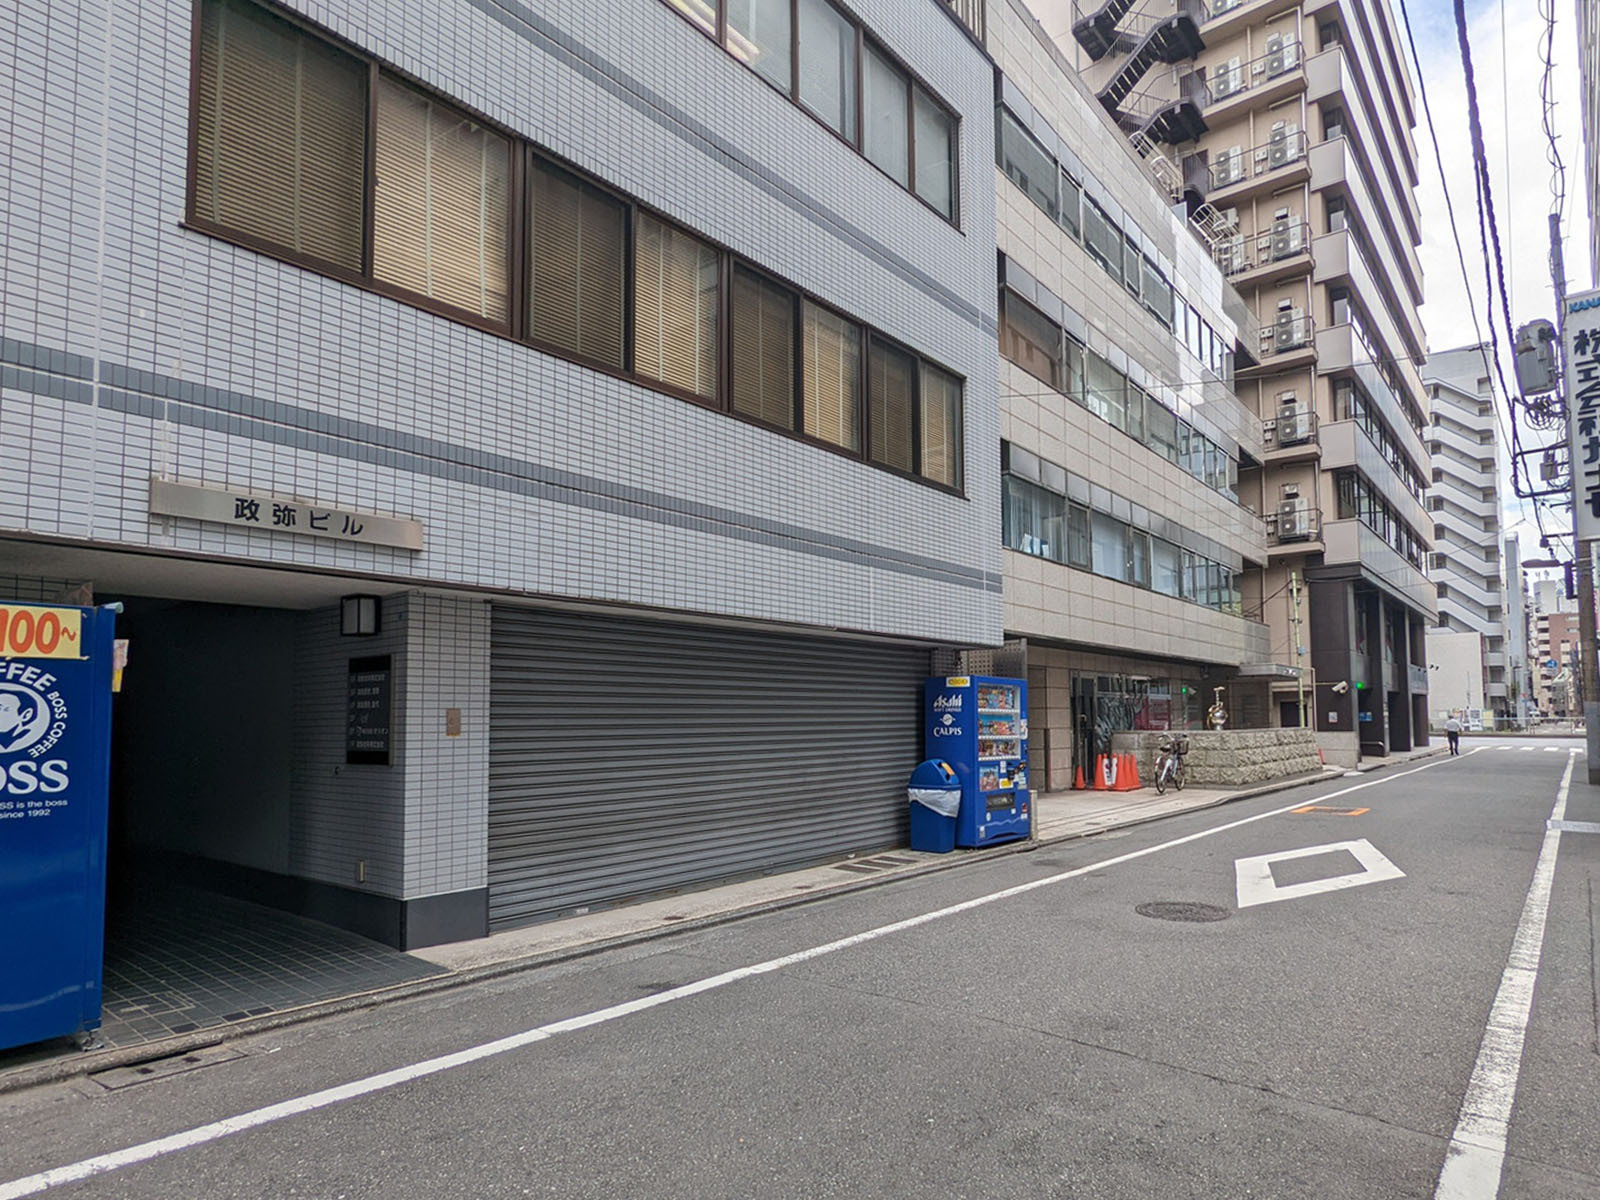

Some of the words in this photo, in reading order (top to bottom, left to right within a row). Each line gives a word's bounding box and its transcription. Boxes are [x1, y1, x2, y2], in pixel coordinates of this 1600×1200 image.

[234, 497, 364, 536] 政弥ビル
[46, 690, 68, 719] BOSS
[933, 694, 962, 708] Asahi
[27, 721, 66, 759] COFFEE
[933, 727, 962, 737] CALPIS
[0, 759, 70, 795] SS
[16, 801, 25, 809] is
[27, 800, 43, 808] the
[45, 799, 68, 807] boss
[27, 808, 52, 817] 1992
